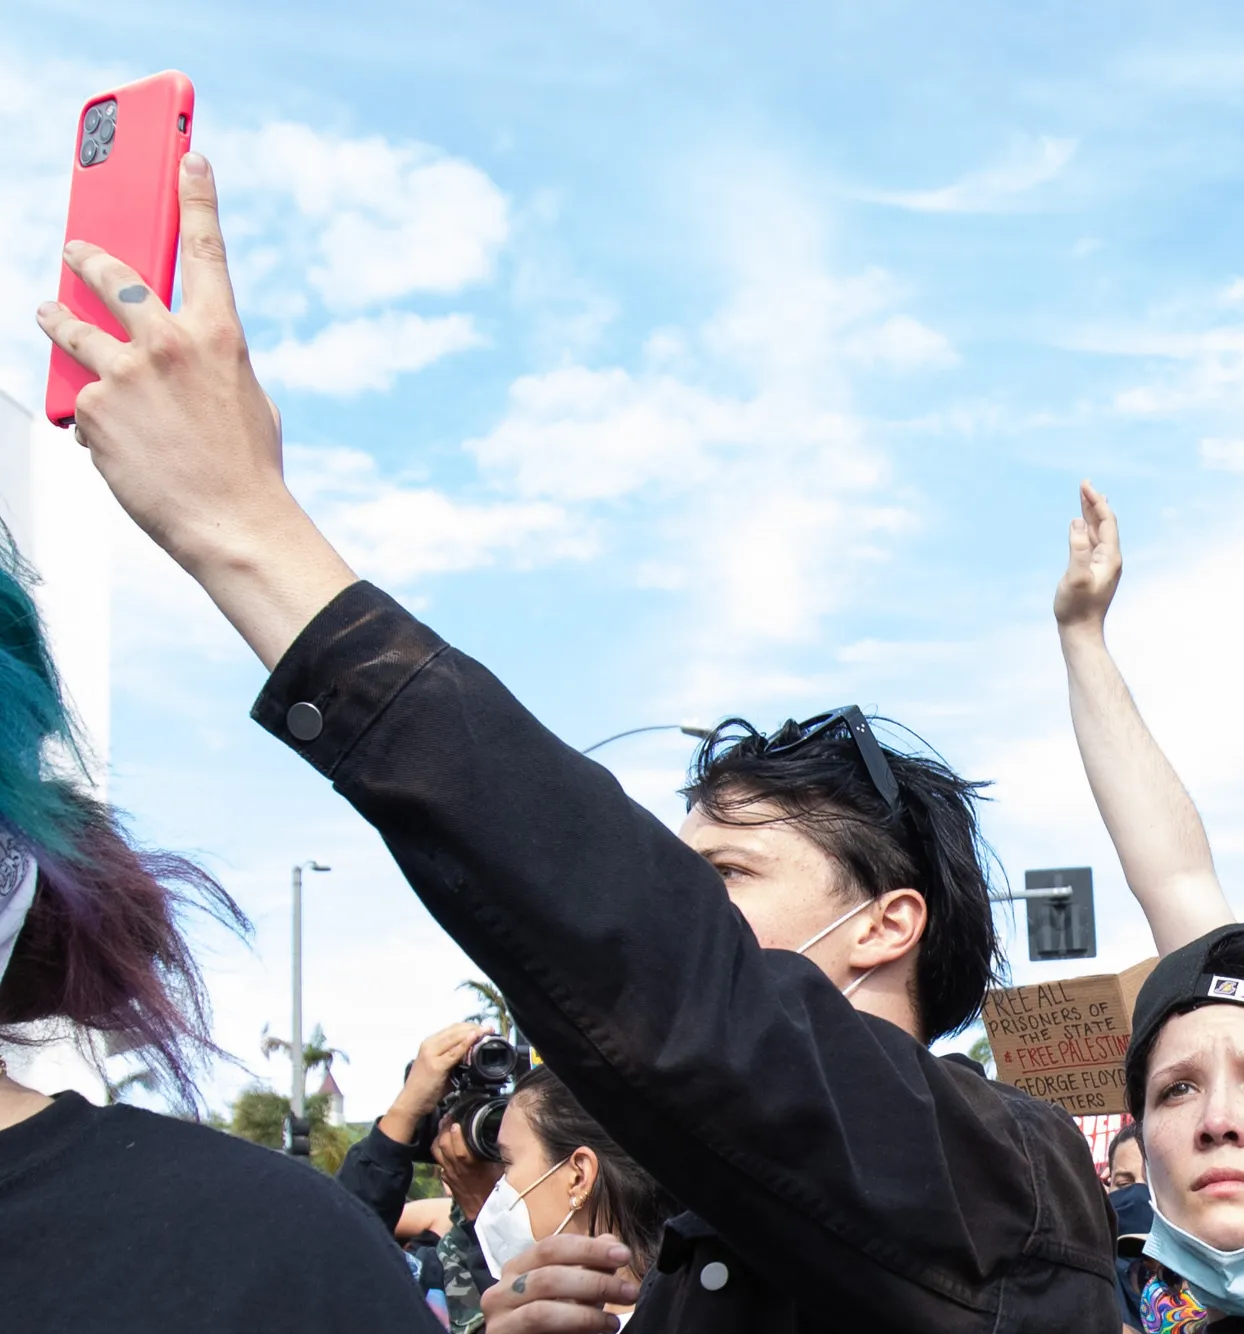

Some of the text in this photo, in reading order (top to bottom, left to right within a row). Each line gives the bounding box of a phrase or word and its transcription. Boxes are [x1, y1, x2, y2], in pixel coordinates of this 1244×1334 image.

[1037, 982, 1075, 1009] ALL
[988, 1001, 1109, 1039] PRISONERS OF
[1019, 1016, 1117, 1046] THE STATE
[1016, 1045, 1060, 1070] FREE
[1014, 1068, 1127, 1097] GEORGE FLOYD
